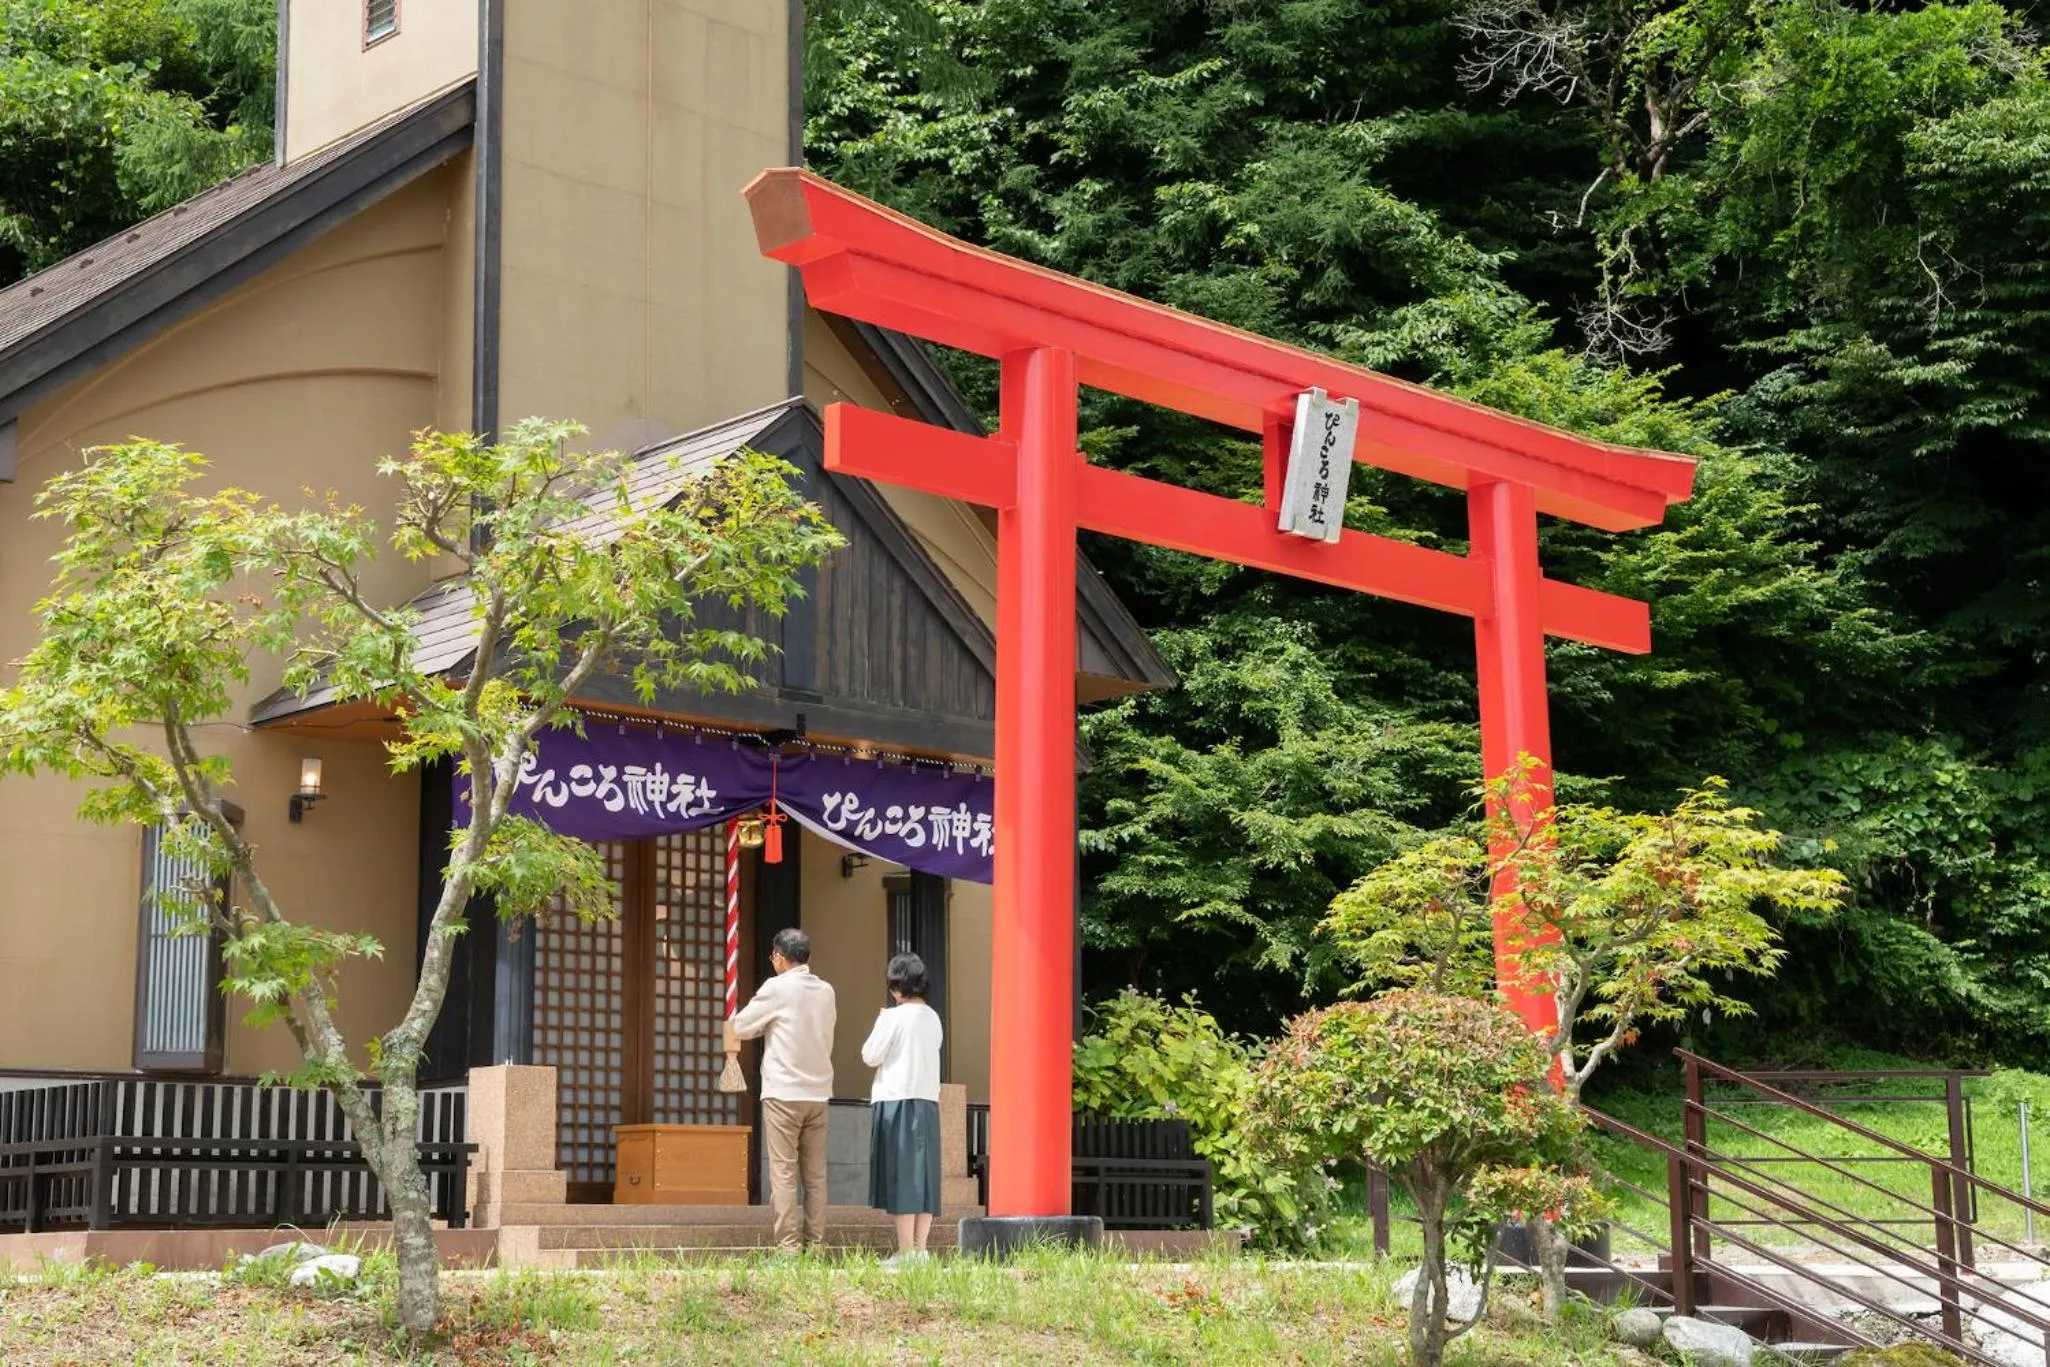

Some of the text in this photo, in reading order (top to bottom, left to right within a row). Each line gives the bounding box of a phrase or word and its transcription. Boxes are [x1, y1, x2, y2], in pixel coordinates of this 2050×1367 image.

[1309, 412, 1340, 525] ぴんころ神社
